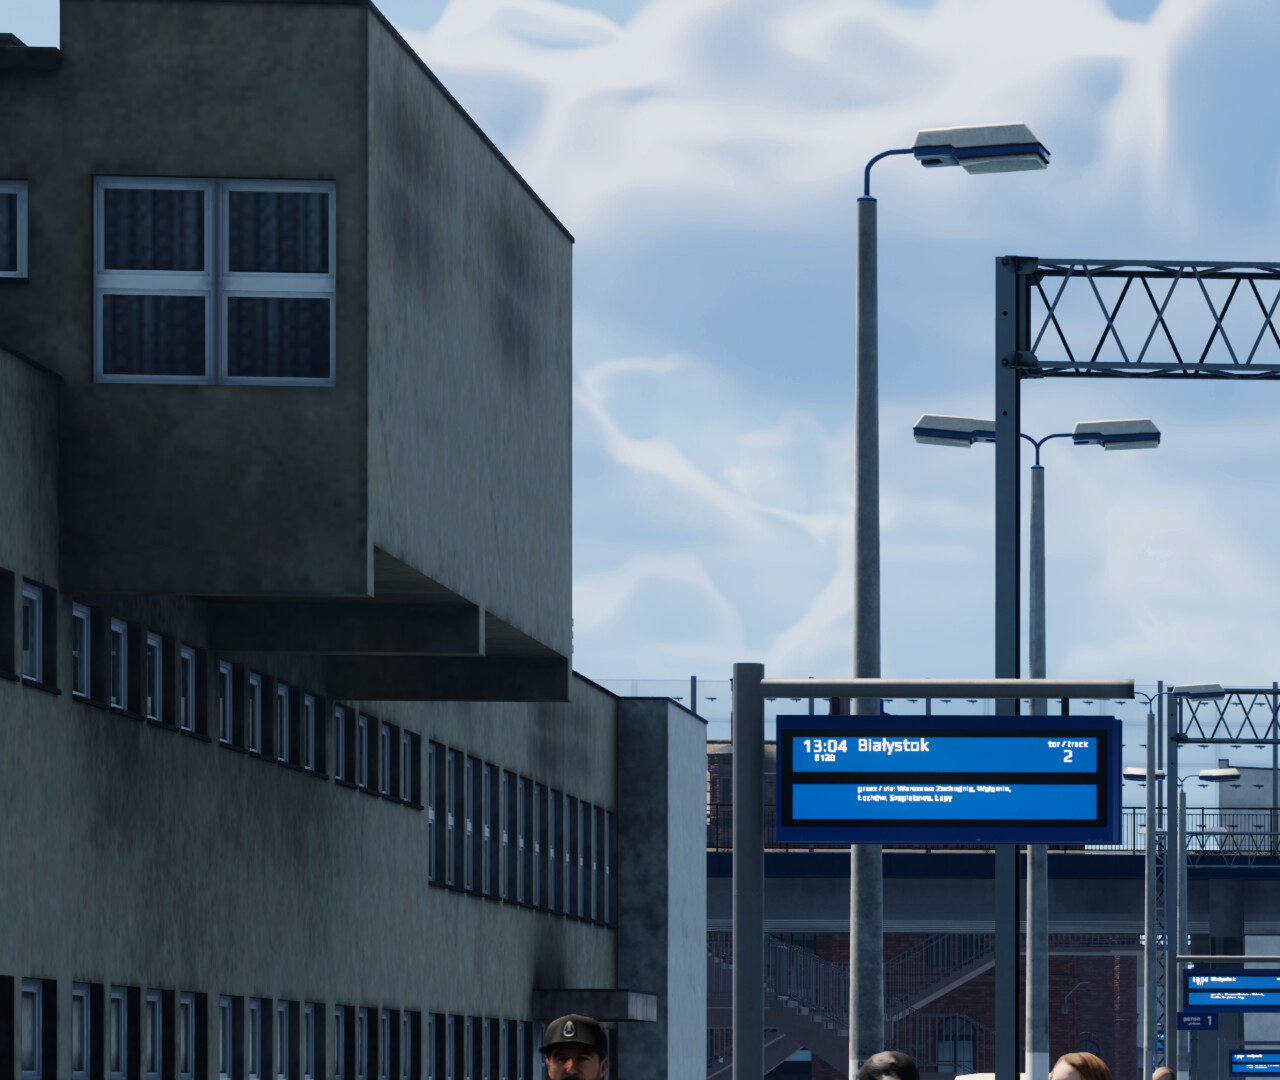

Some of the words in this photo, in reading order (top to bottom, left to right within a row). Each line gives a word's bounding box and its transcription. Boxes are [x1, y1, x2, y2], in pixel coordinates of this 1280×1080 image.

[803, 739, 848, 753] 13:04
[858, 737, 930, 756] Białystok
[1063, 749, 1073, 763] 2
